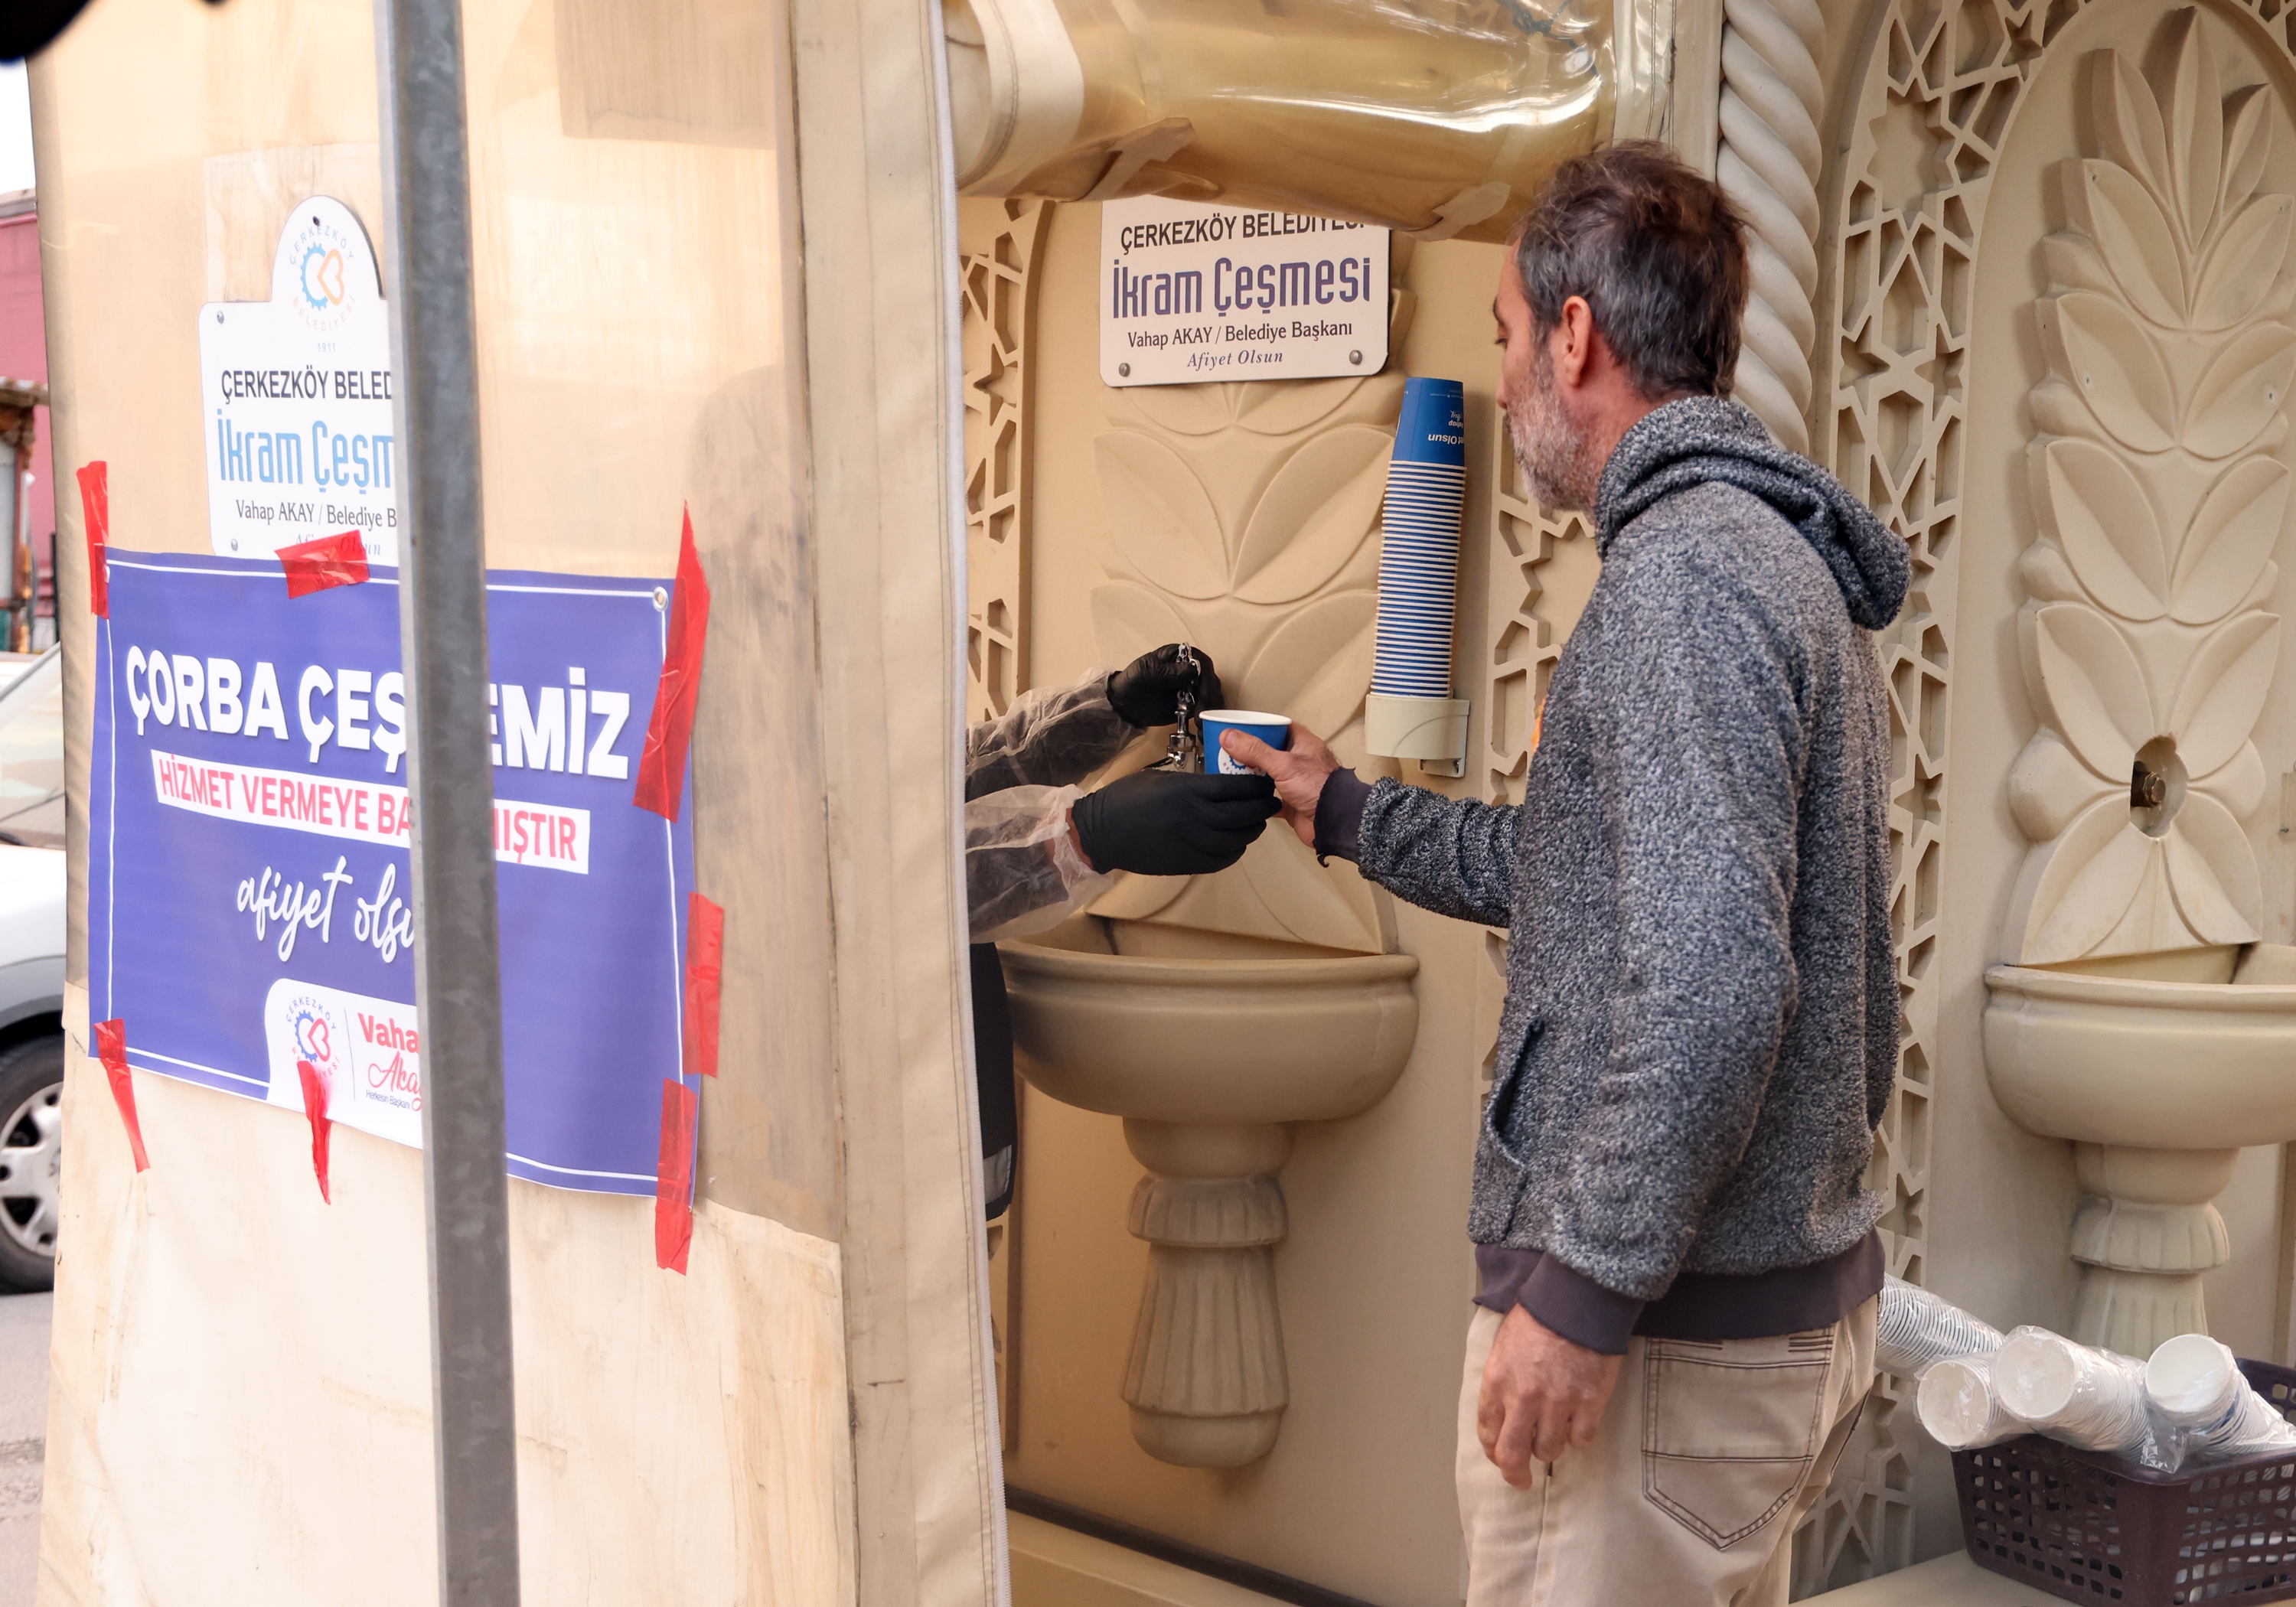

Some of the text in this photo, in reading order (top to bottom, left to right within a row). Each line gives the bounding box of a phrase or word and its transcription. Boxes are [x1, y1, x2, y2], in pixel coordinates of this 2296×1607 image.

[1121, 213, 1237, 255] ÇERKEZKÖY
[1114, 257, 1370, 318] İkram Çeşmesi
[318, 342, 335, 352] 1911
[1128, 331, 1168, 350] Vahap
[1172, 327, 1212, 344] AKAY
[1225, 323, 1287, 344] Belediye
[1292, 320, 1352, 341] Başkanı
[1187, 350, 1283, 371] Afiyet Olsun
[221, 365, 393, 404] ÇERKEZKÖY BELED
[217, 409, 394, 494] İkram Çeşm
[1427, 433, 1457, 445] Olsun
[236, 500, 274, 525] Vahap
[279, 502, 315, 522] AKAY
[327, 504, 383, 531] Belediye
[126, 645, 289, 740] ÇORBA
[159, 754, 234, 810] HİZMET
[241, 774, 368, 830] VERMEYE
[237, 855, 415, 963] afiyet olsu
[357, 1012, 420, 1054] Vaha
[366, 1089, 389, 1103] Herkesin
[368, 1051, 422, 1111] Aka
